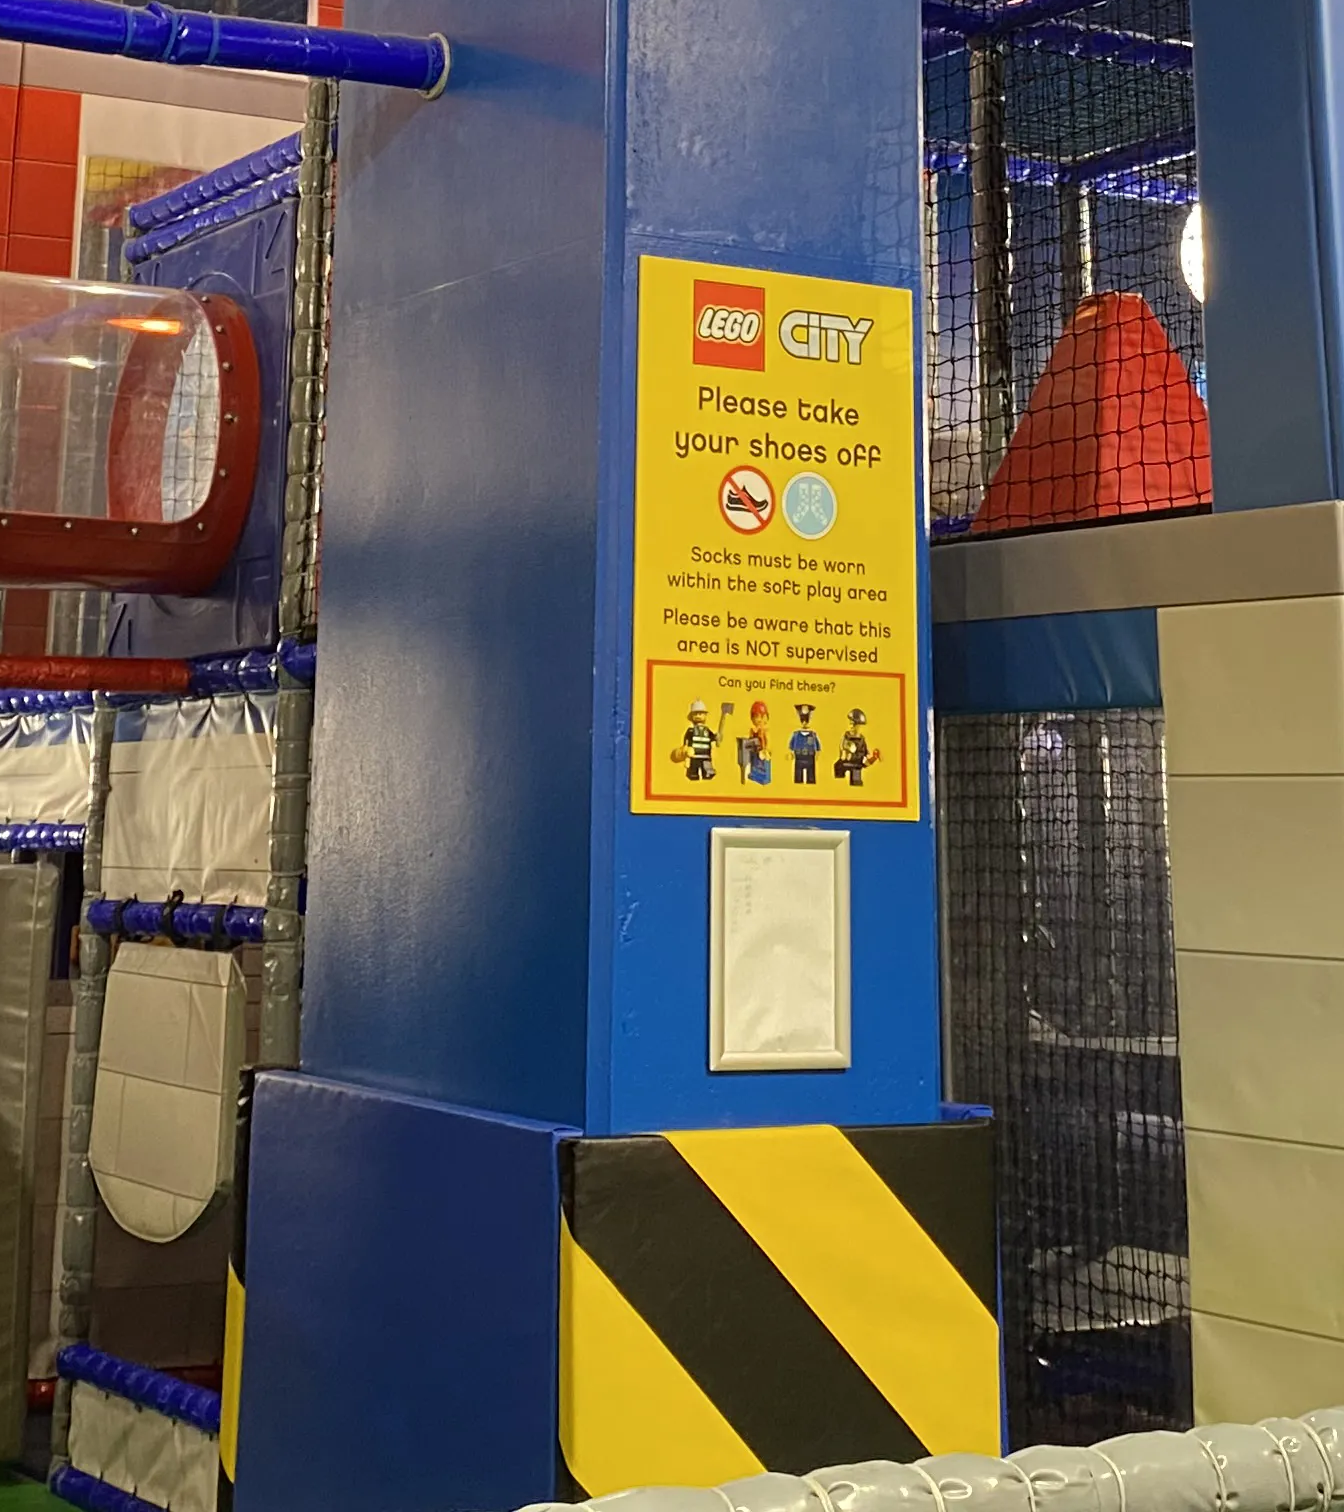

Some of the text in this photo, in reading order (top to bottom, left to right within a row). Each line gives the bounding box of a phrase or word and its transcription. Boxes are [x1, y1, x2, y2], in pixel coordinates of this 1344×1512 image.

[698, 306, 874, 365] LEGO CITY
[698, 386, 859, 426] Please take
[675, 430, 881, 468] your shoes off
[691, 546, 865, 575] Socks must be worn
[667, 571, 887, 604] within the soft play area
[663, 608, 892, 639] Please be aware that this
[677, 638, 878, 664] area is NOT supervised
[718, 676, 836, 693] Can you find these?
